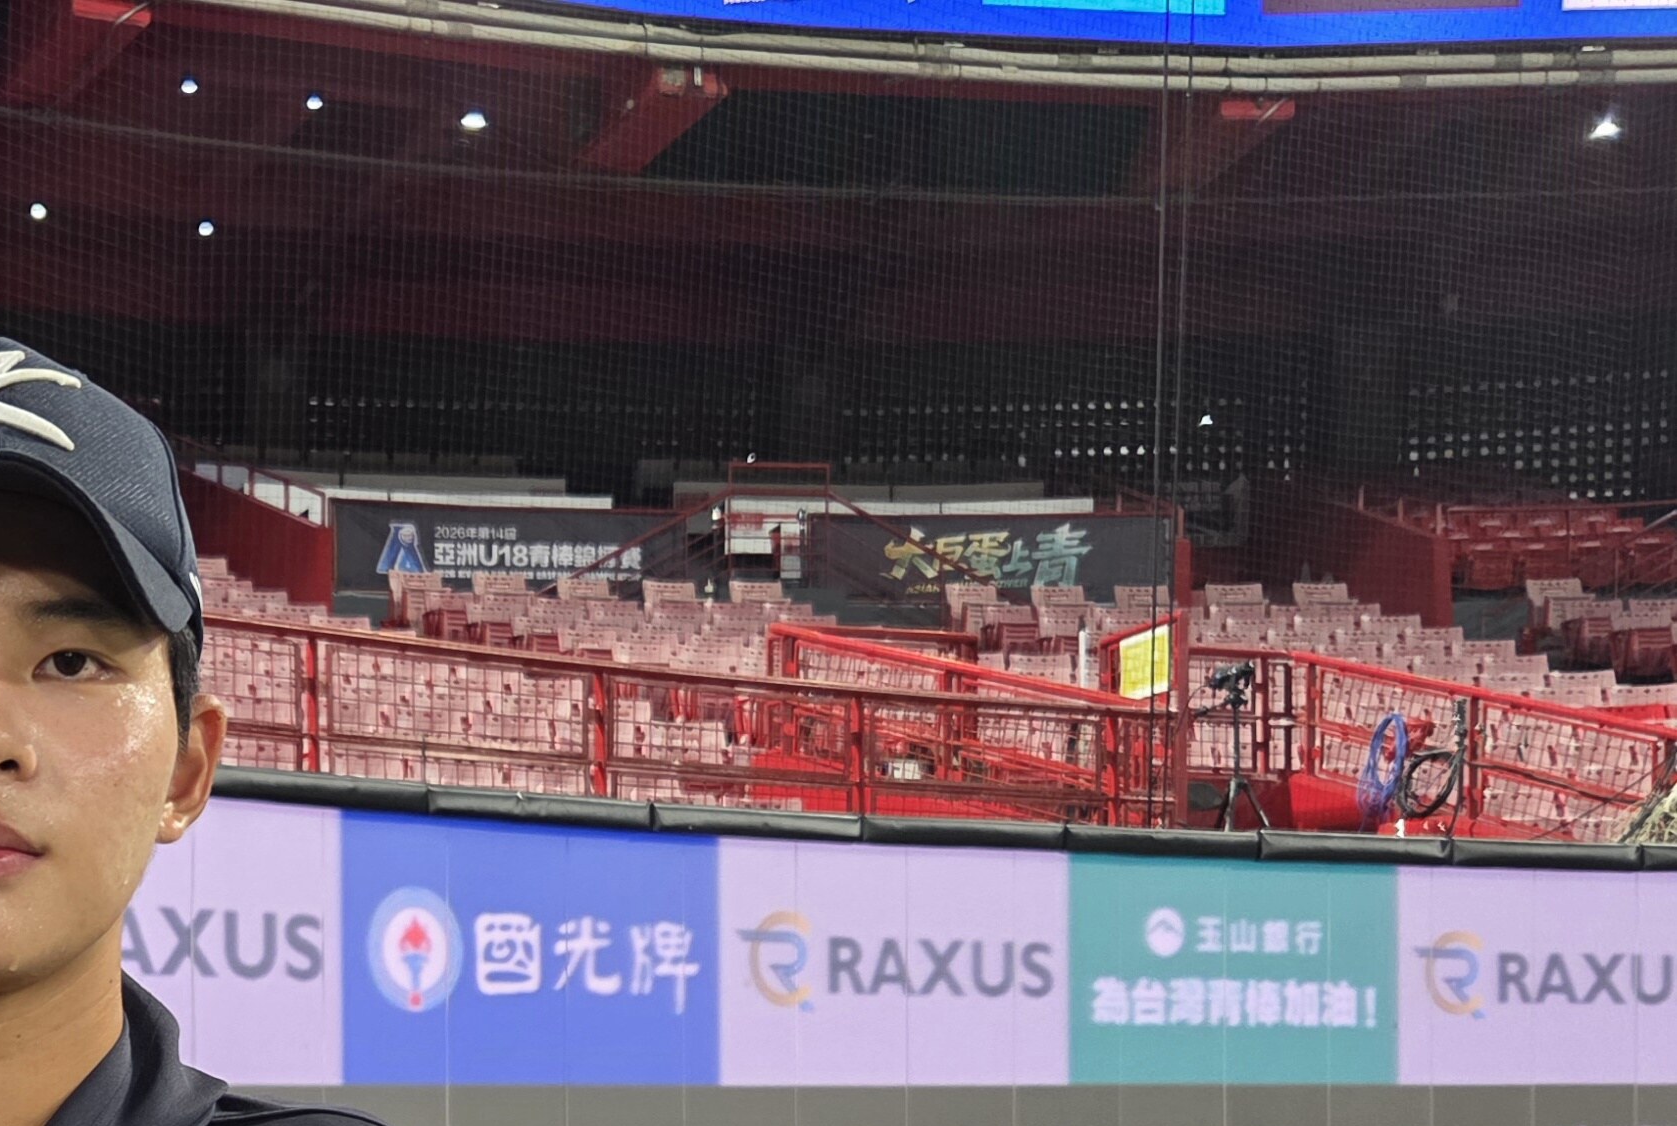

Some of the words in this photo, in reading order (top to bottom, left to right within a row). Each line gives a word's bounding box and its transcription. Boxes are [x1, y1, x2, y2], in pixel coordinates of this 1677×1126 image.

[474, 912, 700, 1015] 國光牌
[828, 936, 1055, 998] RAXUS
